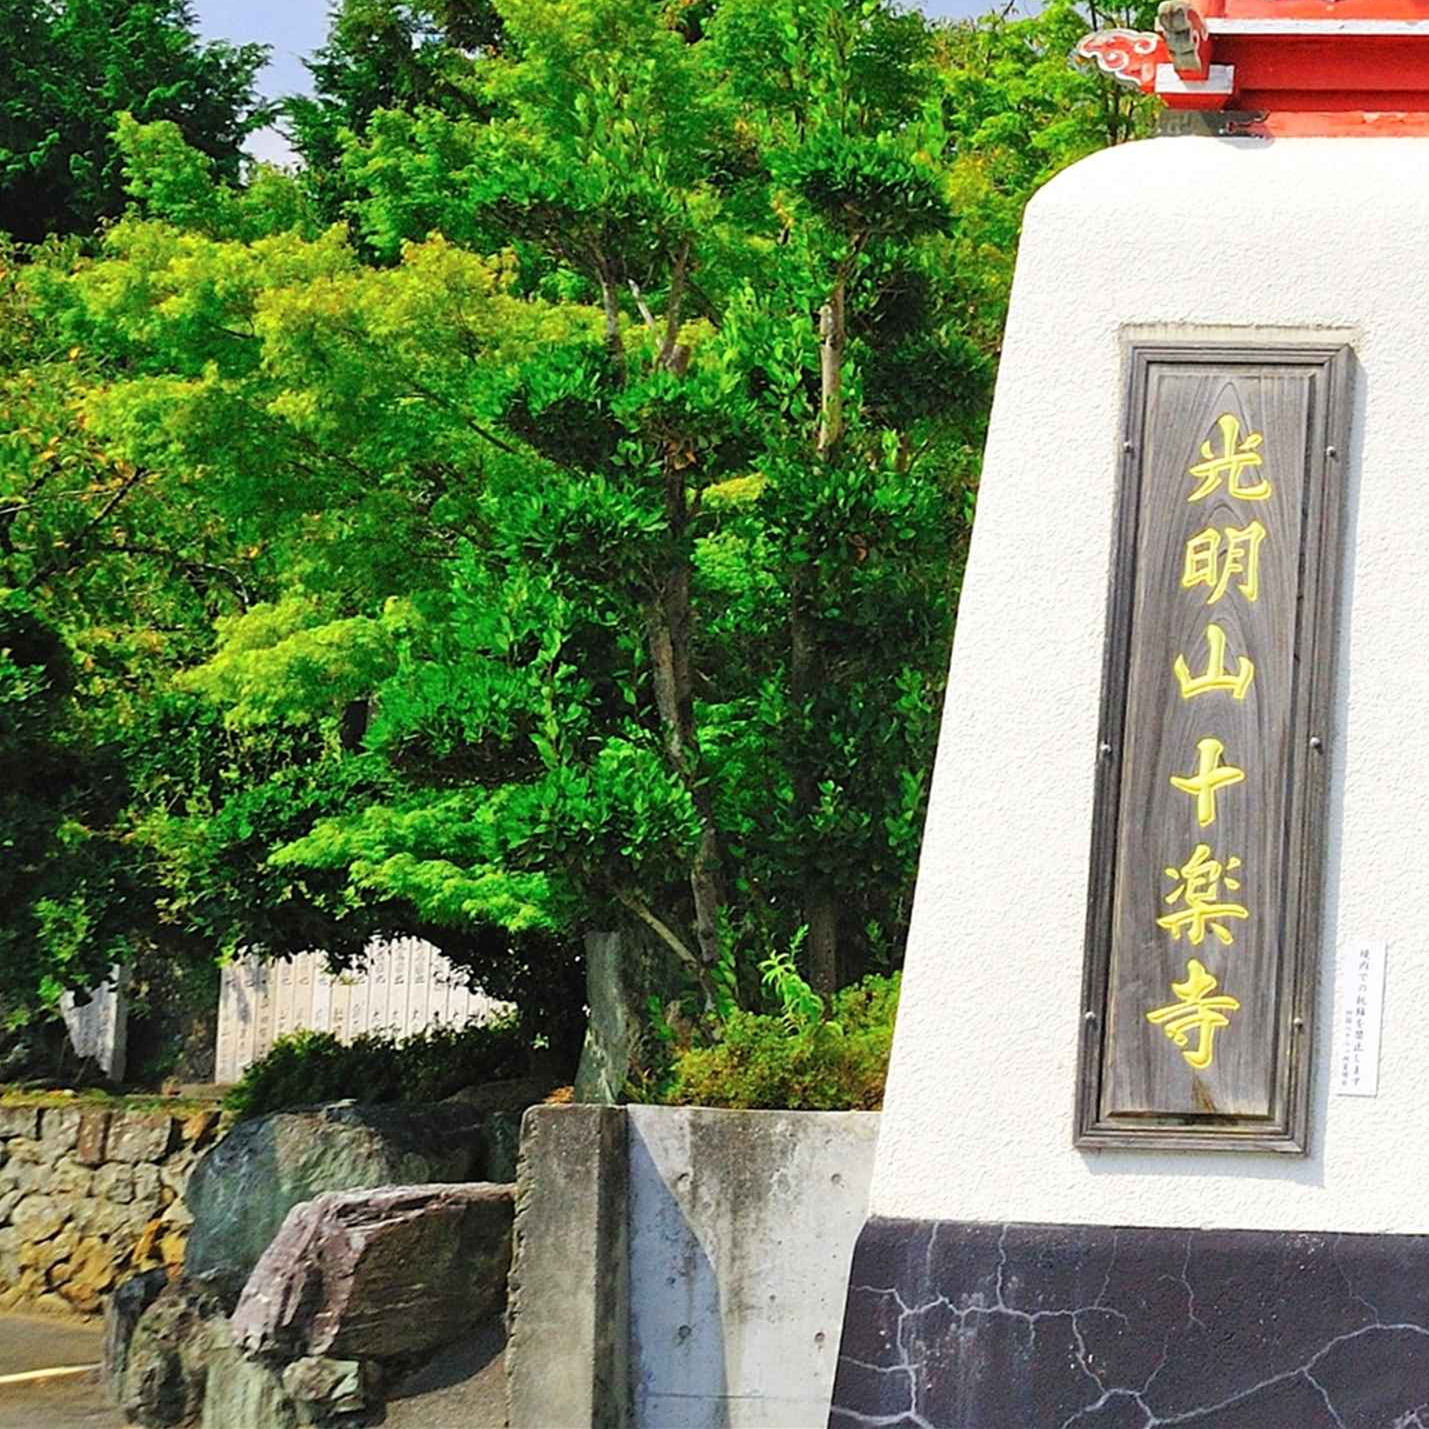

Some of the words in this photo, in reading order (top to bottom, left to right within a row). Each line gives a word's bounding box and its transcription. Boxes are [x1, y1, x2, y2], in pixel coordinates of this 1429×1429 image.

[1146, 413, 1272, 1070] 光明山十楽寺
